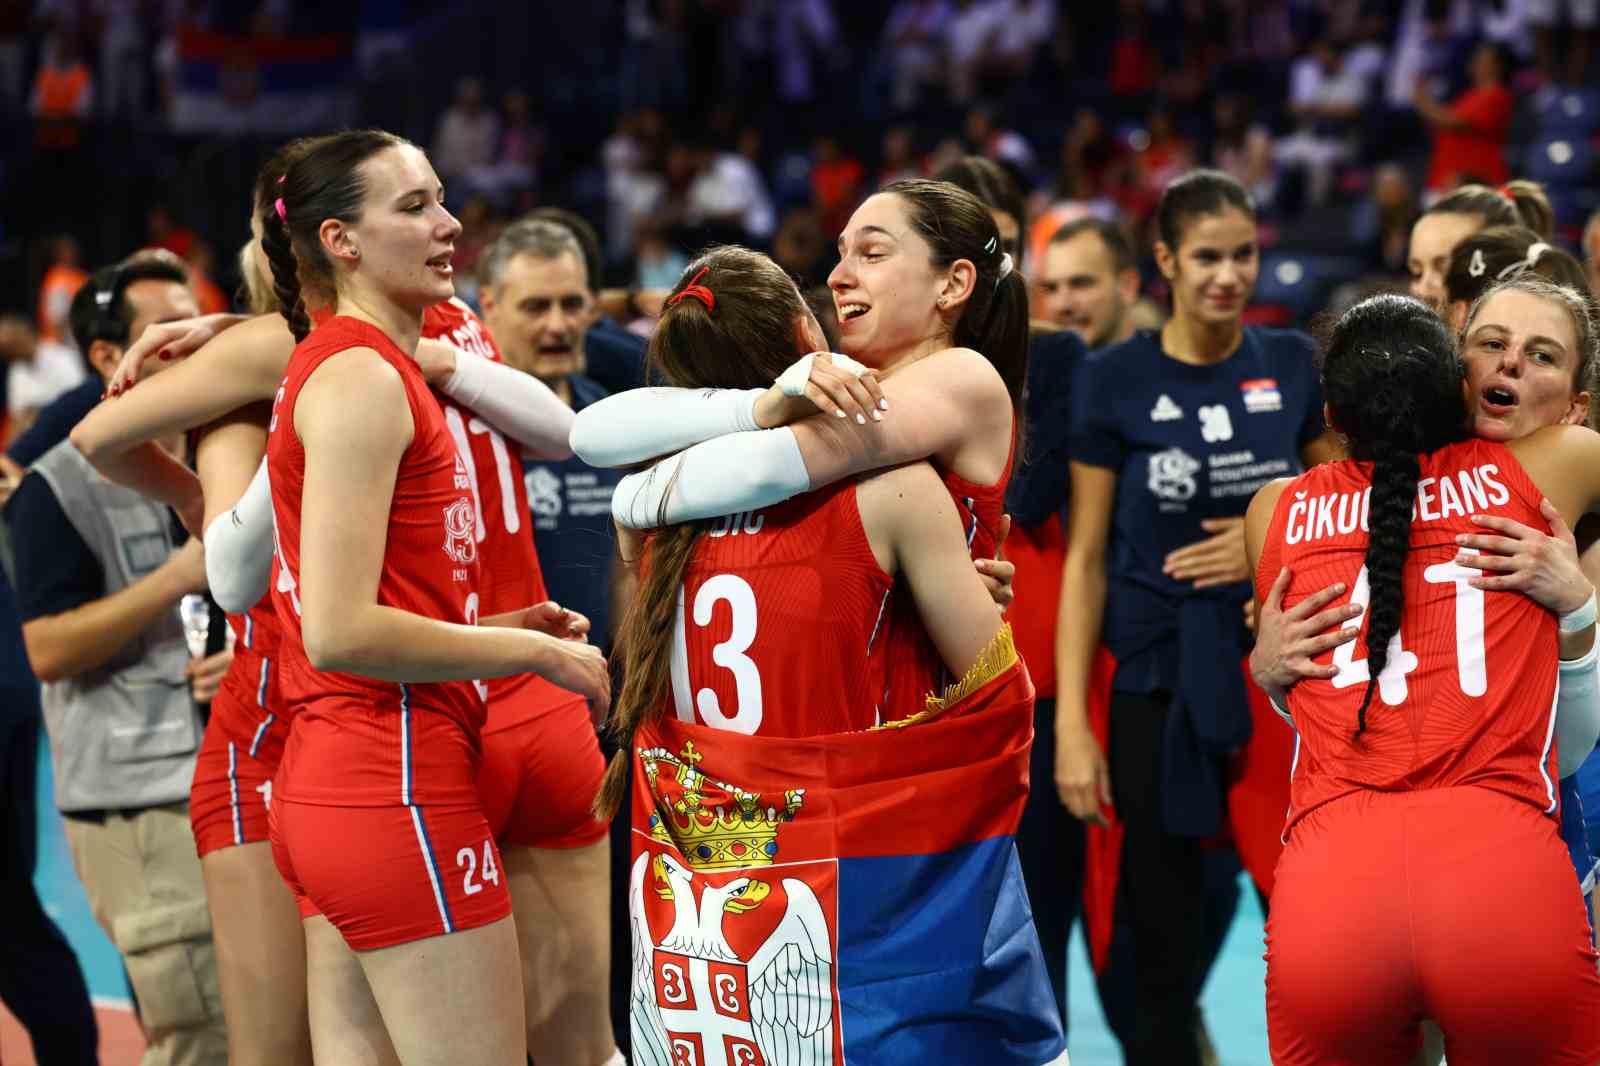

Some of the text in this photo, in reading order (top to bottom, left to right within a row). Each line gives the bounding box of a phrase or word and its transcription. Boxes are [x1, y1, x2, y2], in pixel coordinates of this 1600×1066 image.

[1411, 463, 1510, 523] EANS
[1331, 547, 1487, 705] 41
[456, 840, 499, 896] 24
